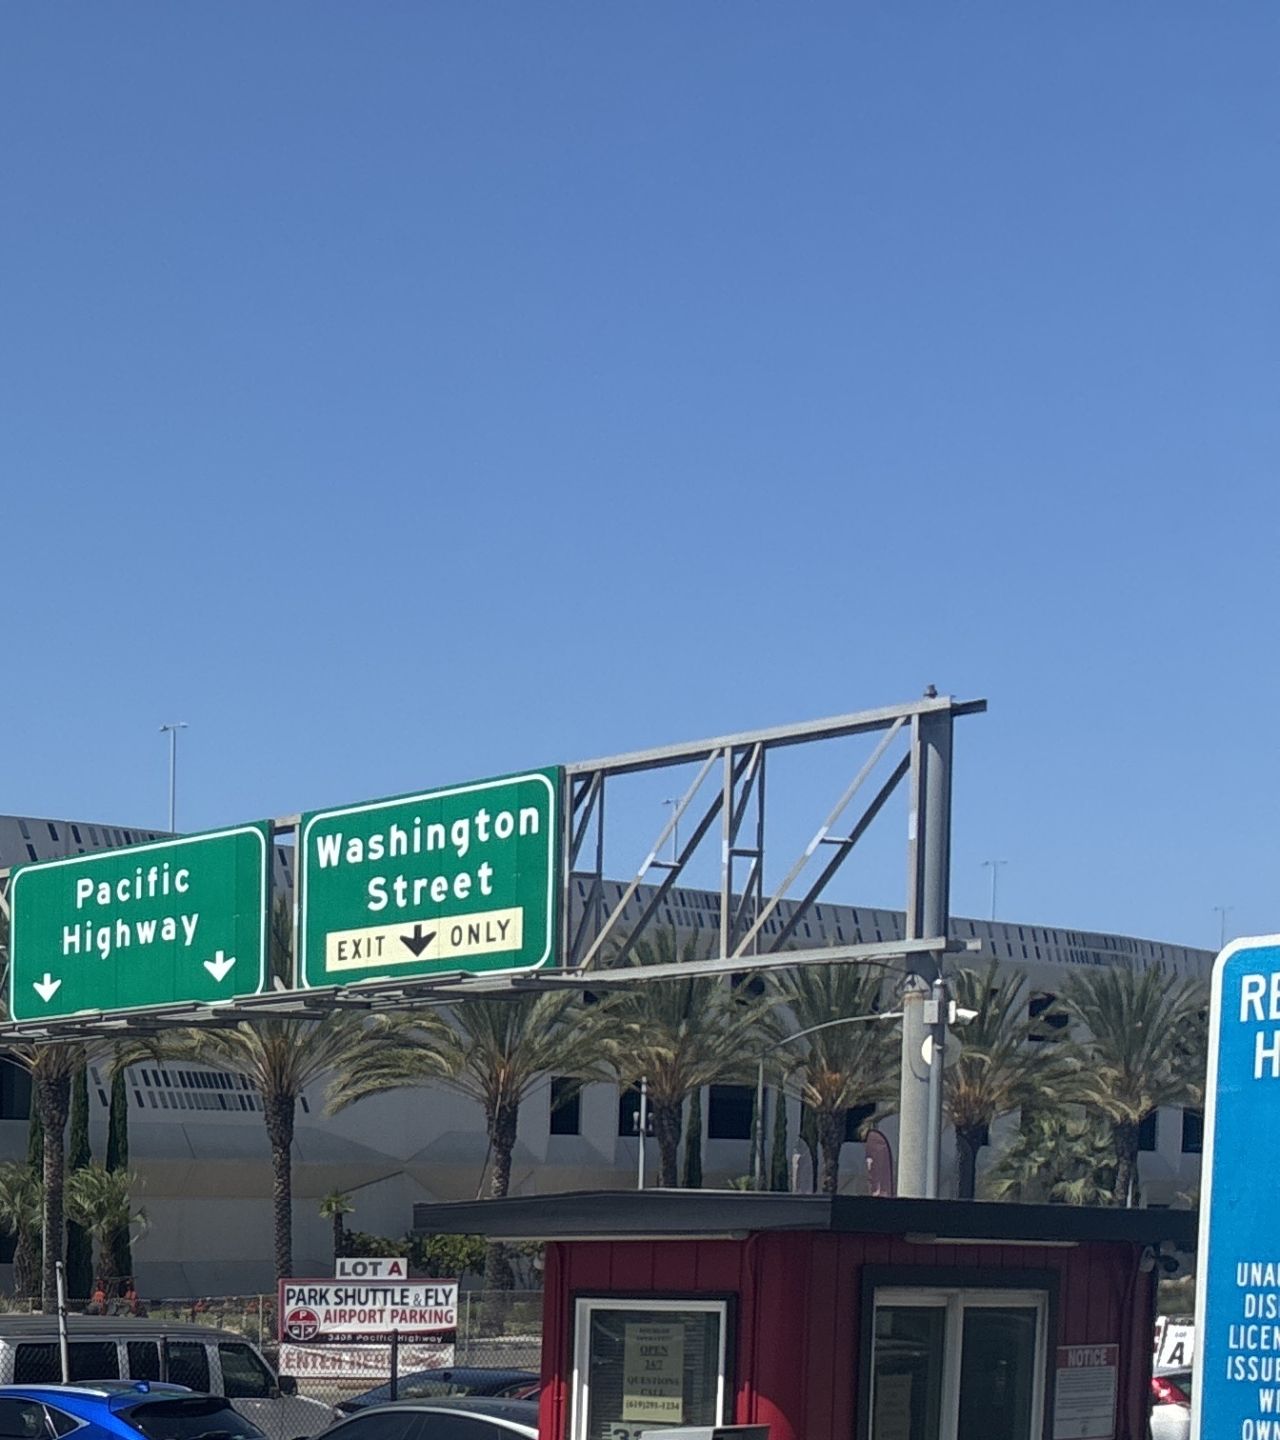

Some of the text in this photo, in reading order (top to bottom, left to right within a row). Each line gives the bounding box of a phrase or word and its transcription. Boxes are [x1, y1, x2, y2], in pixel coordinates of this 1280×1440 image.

[317, 807, 539, 868] Washington
[77, 862, 190, 909] Pacific
[367, 861, 493, 911] Street
[63, 913, 199, 960] Highway
[338, 918, 511, 961] EXIT ONLY
[339, 1260, 402, 1277] LOT A
[1237, 1262, 1280, 1287] UNA
[286, 1288, 453, 1307] PARK SHUTTLE & FLY
[1244, 1293, 1280, 1319] DIS
[323, 1309, 454, 1324] AIRPORT PARKING
[356, 1333, 392, 1342] Pacific
[397, 1333, 443, 1344] Highway
[1068, 1349, 1107, 1366] NOTICE
[1167, 1342, 1185, 1365] A
[627, 1375, 679, 1385] QUESTIONS
